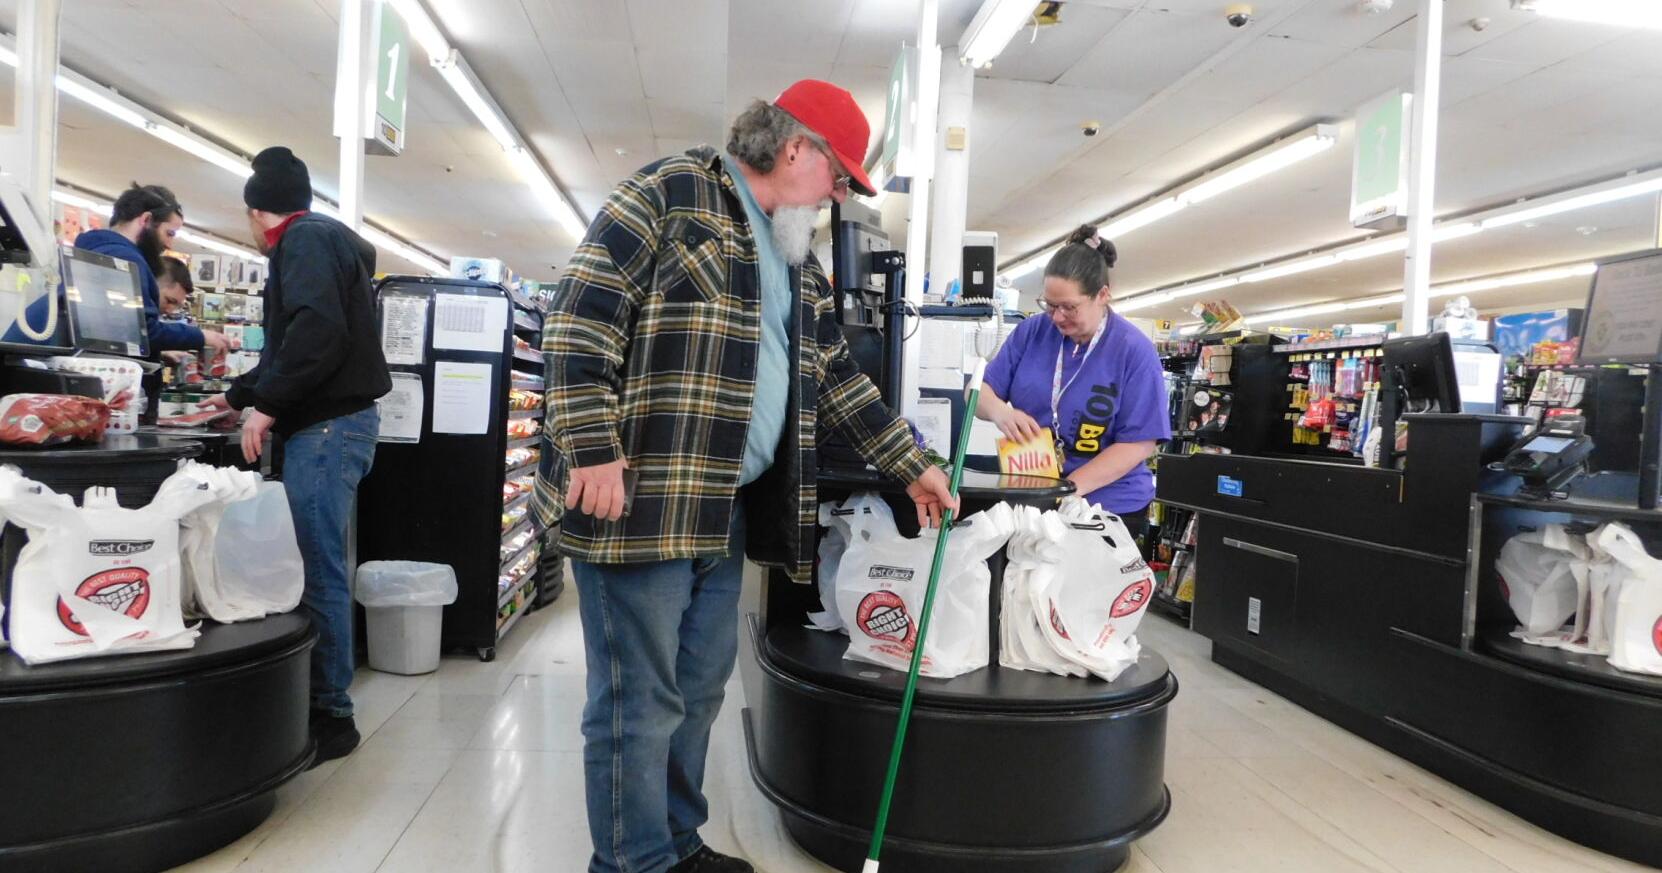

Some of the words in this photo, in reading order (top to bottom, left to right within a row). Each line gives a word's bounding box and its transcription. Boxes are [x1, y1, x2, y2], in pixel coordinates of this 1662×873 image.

[385, 42, 399, 101] 1
[887, 80, 899, 142] 2
[1086, 382, 1118, 417] 10
[1008, 450, 1051, 474] Nilla
[90, 543, 115, 553] Best
[866, 607, 903, 629] RIGHT
